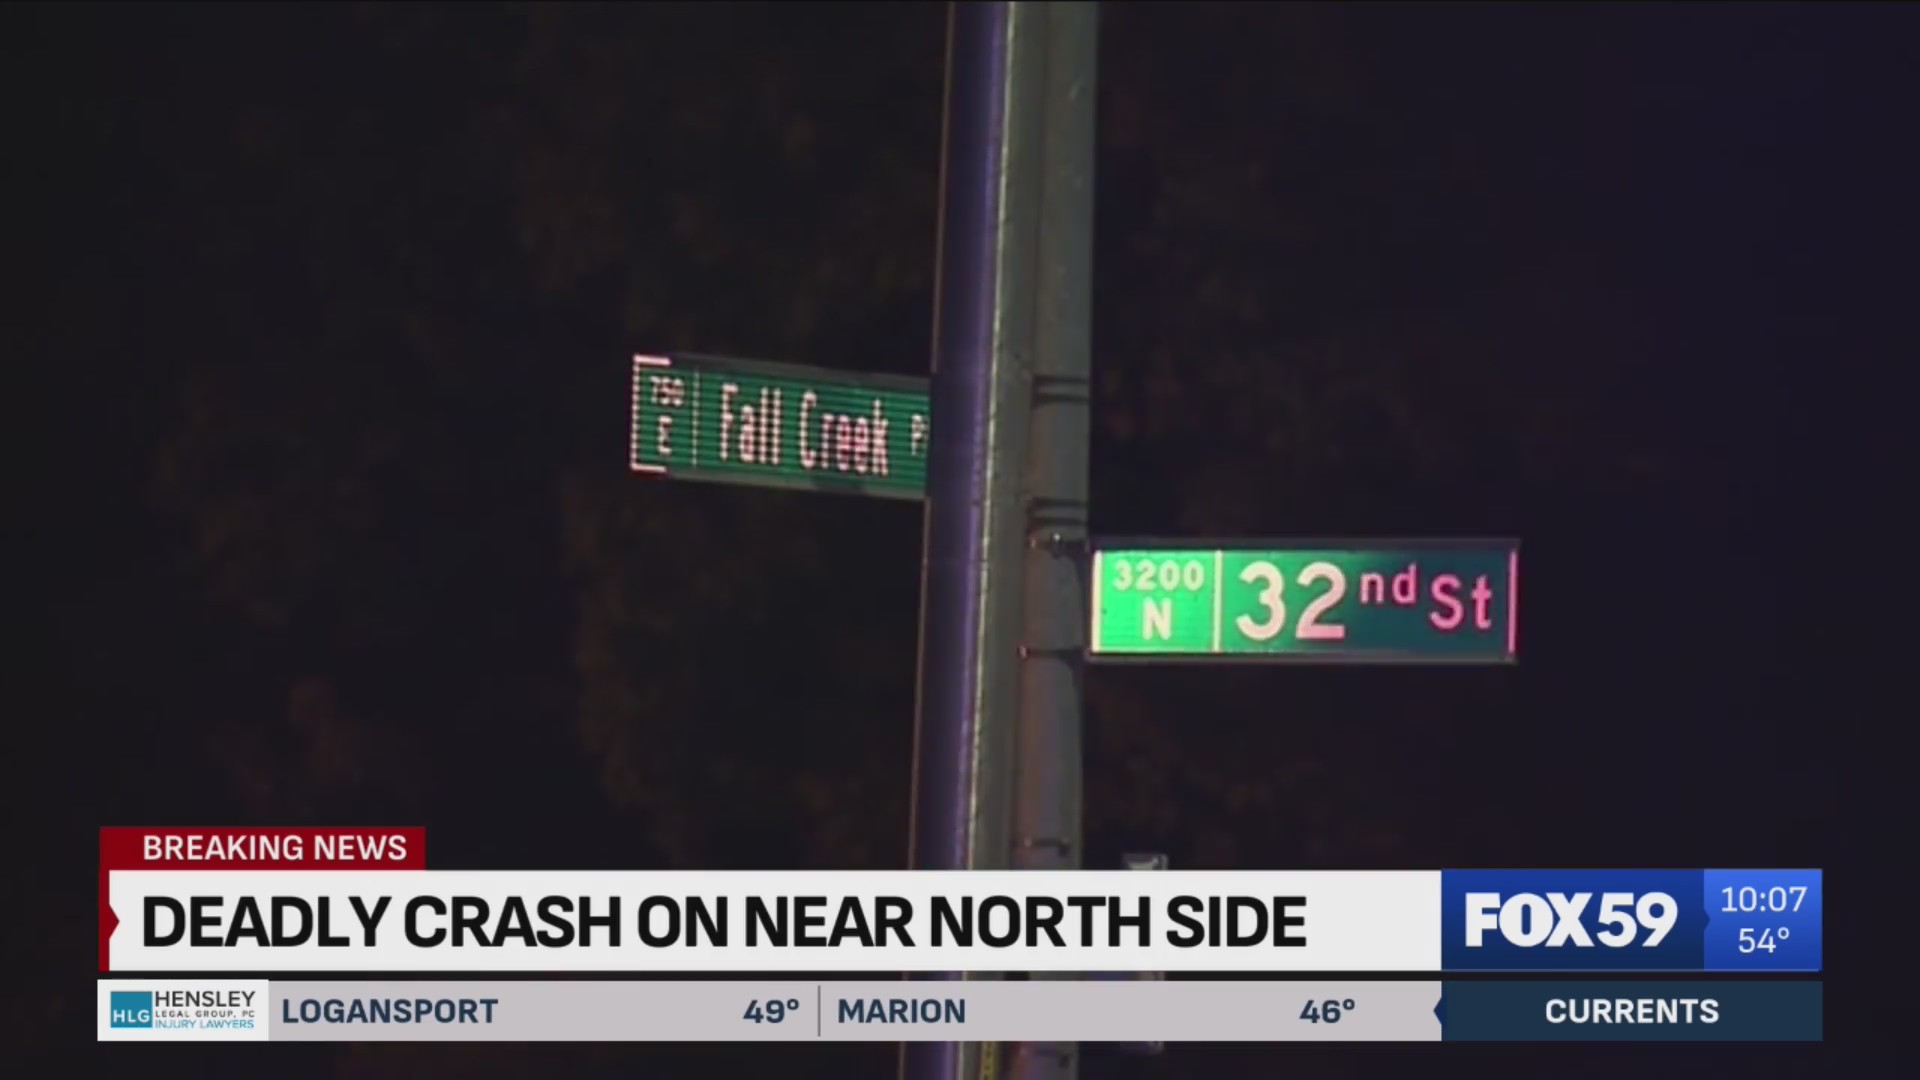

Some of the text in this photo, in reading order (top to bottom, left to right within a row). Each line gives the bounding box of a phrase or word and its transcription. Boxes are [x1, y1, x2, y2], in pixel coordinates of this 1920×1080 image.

[659, 415, 672, 454] E
[721, 383, 781, 464] Fall
[800, 390, 889, 476] Creek
[1112, 559, 1205, 591] 3200
[1142, 597, 1172, 641] N
[1236, 560, 1492, 641] 32nd St
